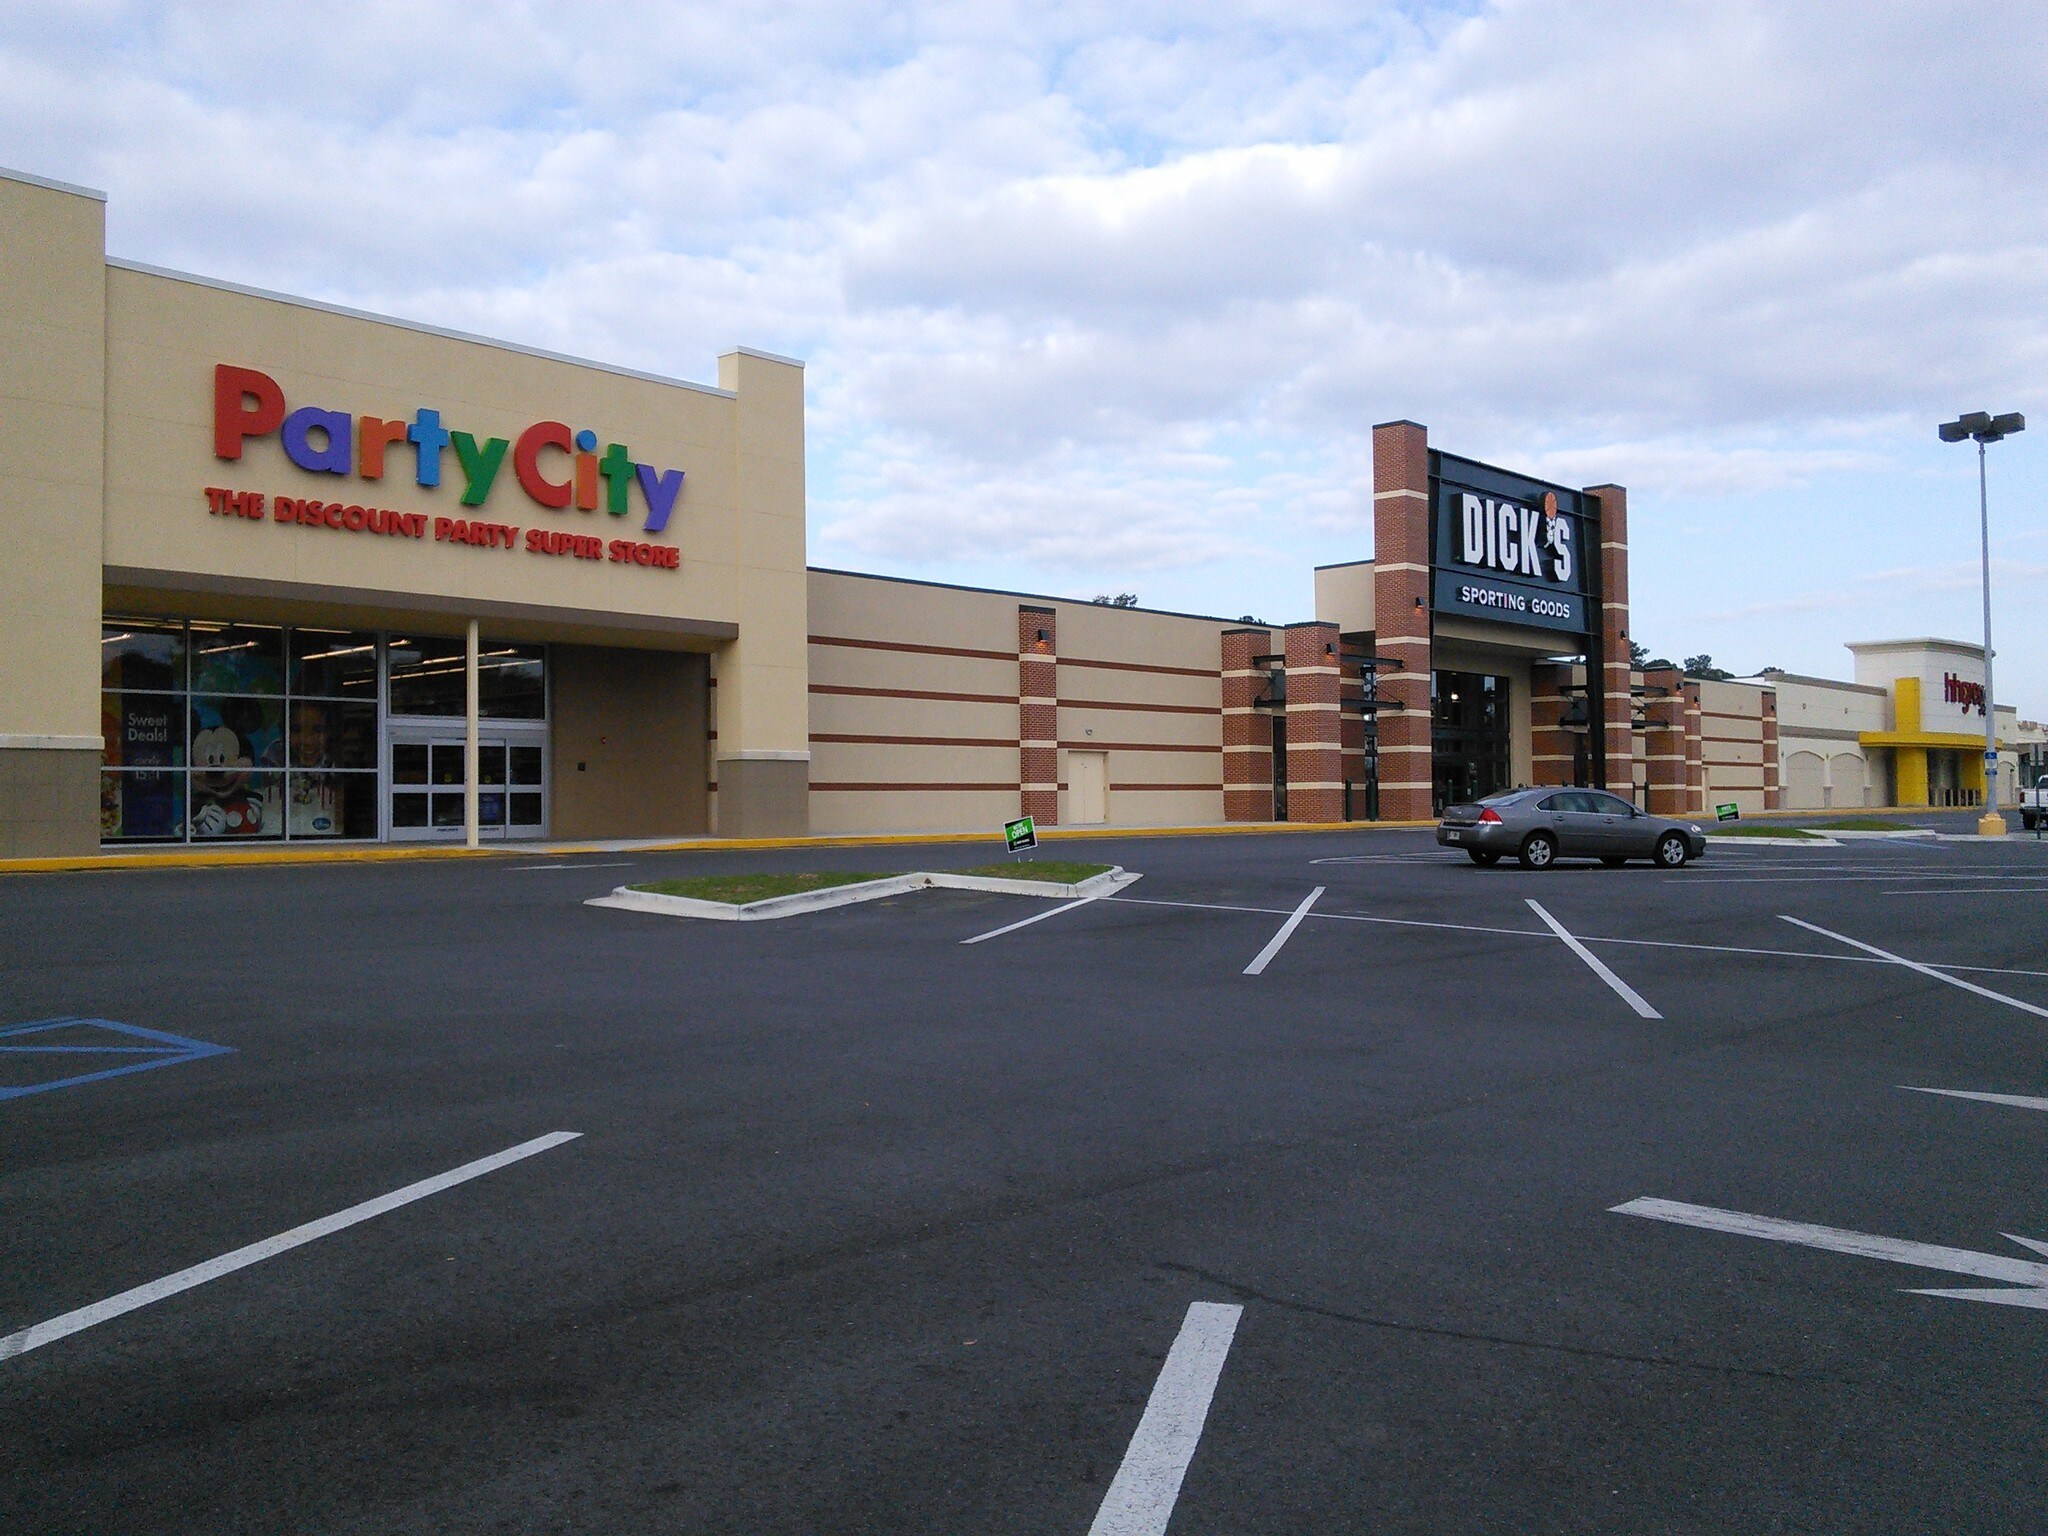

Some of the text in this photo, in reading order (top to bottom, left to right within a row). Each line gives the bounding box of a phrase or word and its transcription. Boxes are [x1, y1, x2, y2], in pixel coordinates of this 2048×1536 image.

[204, 486, 680, 569] THE DISCOUNT PARTY SUPER STORE
[1462, 492, 1572, 582] DICK'S
[1462, 585, 1571, 619] SPORTING GOODS
[128, 712, 168, 727] Sweet
[128, 727, 168, 742] Deals!
